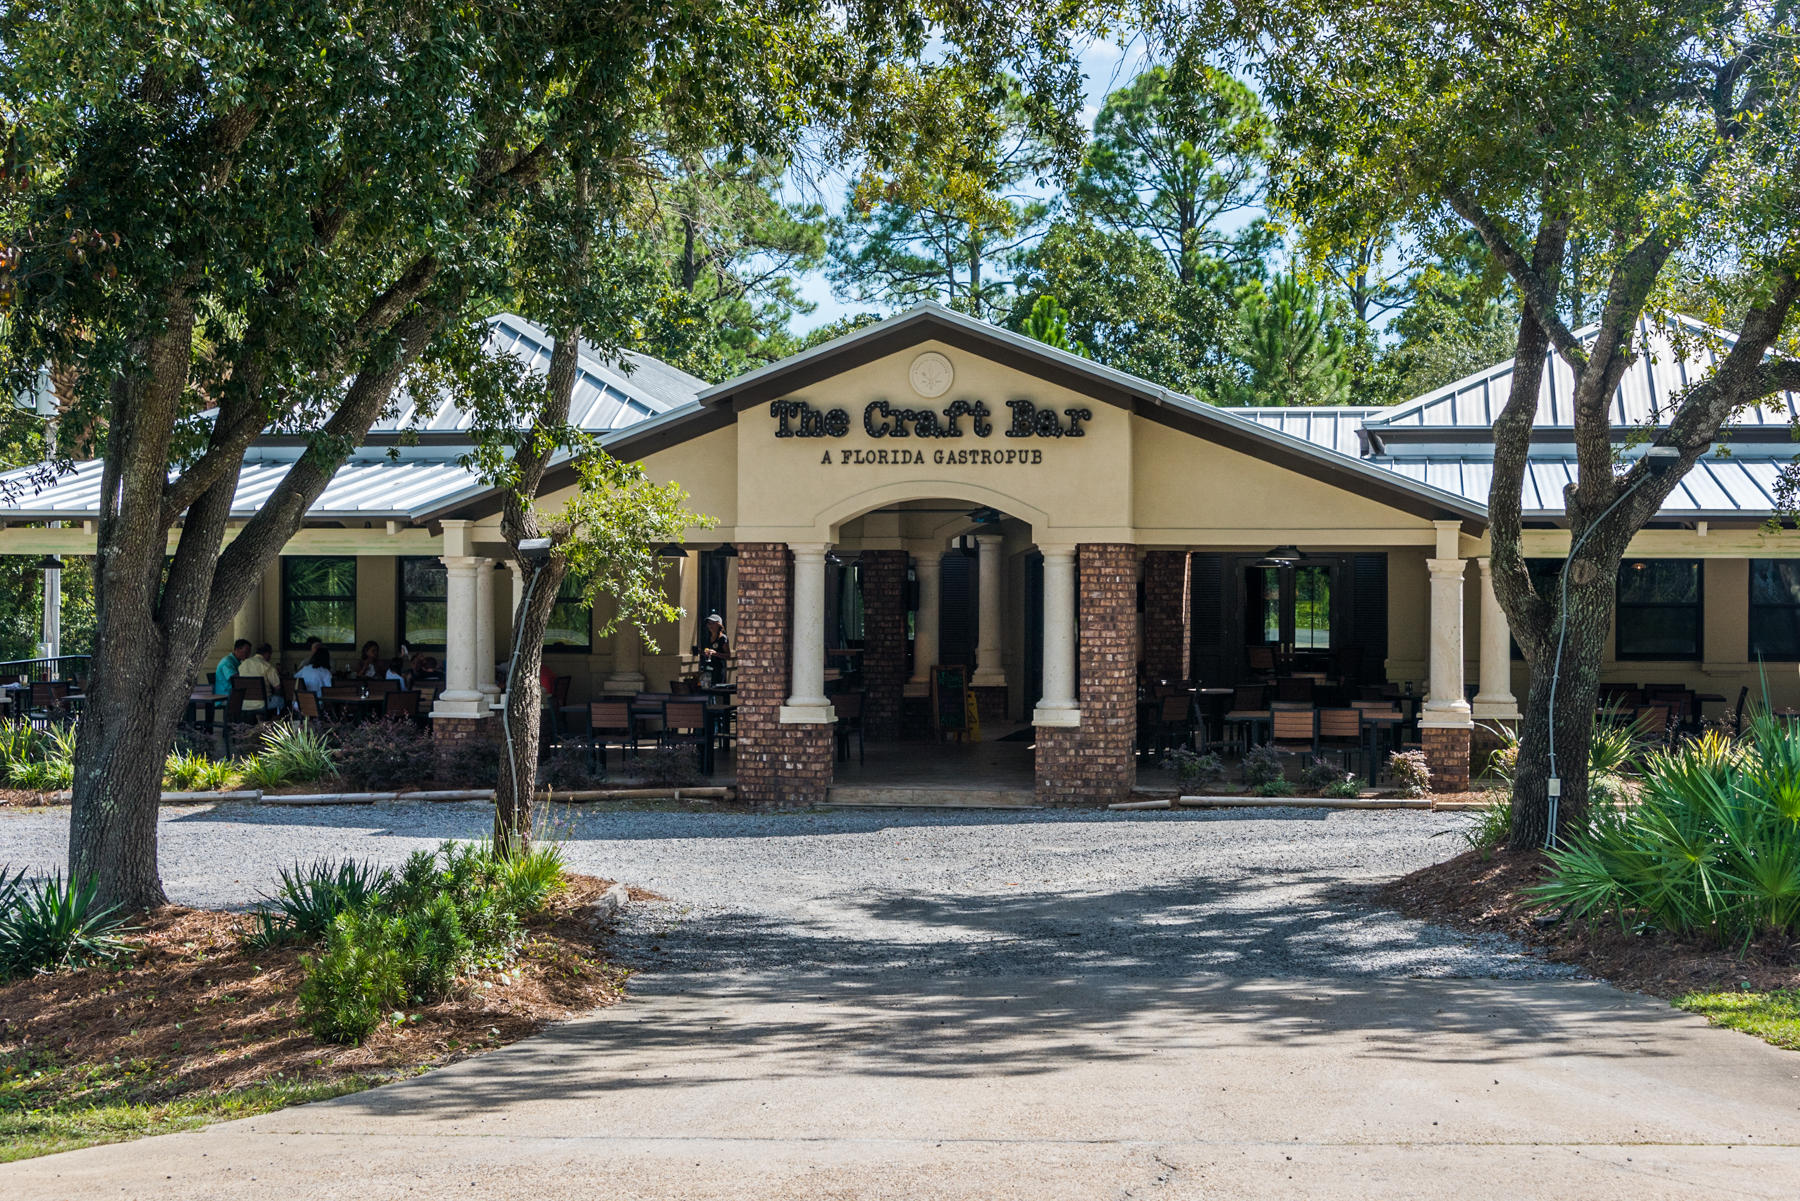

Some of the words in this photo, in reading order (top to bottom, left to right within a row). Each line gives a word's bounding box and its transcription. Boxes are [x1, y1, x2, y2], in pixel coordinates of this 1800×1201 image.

[770, 400, 851, 438] The
[863, 400, 993, 439] Craft
[1005, 400, 1092, 439] Bar
[821, 449, 832, 465] A
[841, 449, 925, 465] FLORIDA
[934, 449, 1043, 465] GASTROPUB
